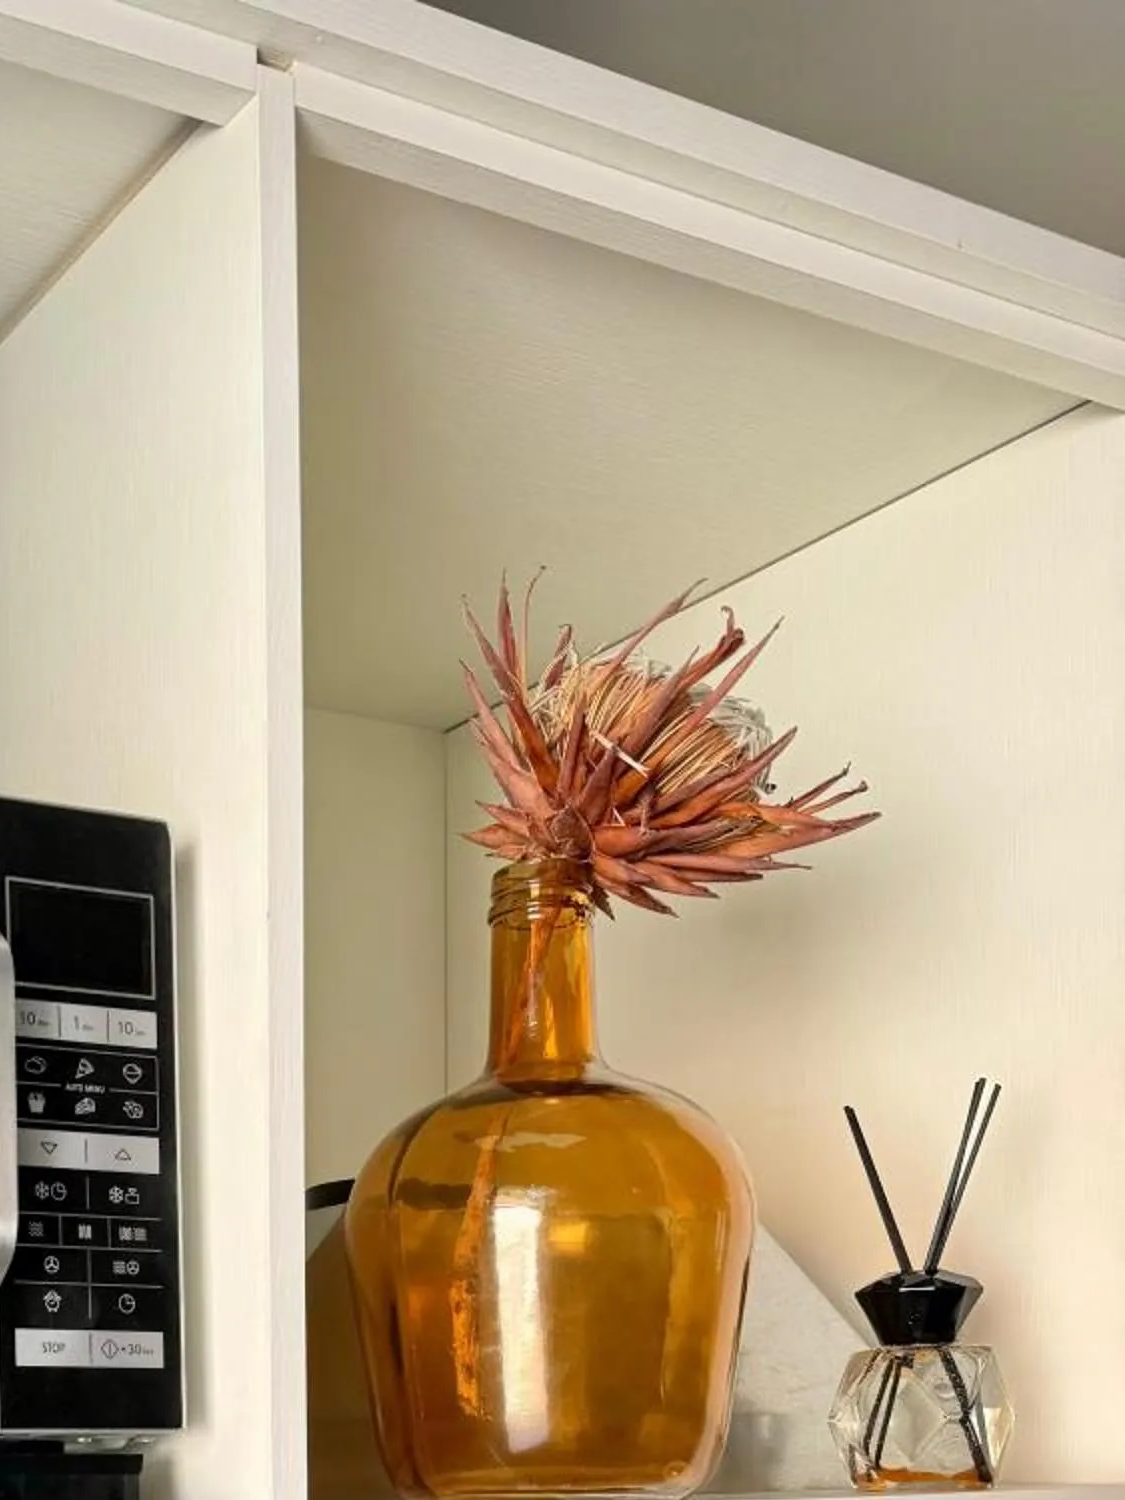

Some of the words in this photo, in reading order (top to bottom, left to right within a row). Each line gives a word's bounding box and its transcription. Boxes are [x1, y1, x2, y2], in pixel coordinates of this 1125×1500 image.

[19, 1011, 36, 1025] 10
[118, 1021, 134, 1035] 10
[42, 1341, 65, 1354] STOP
